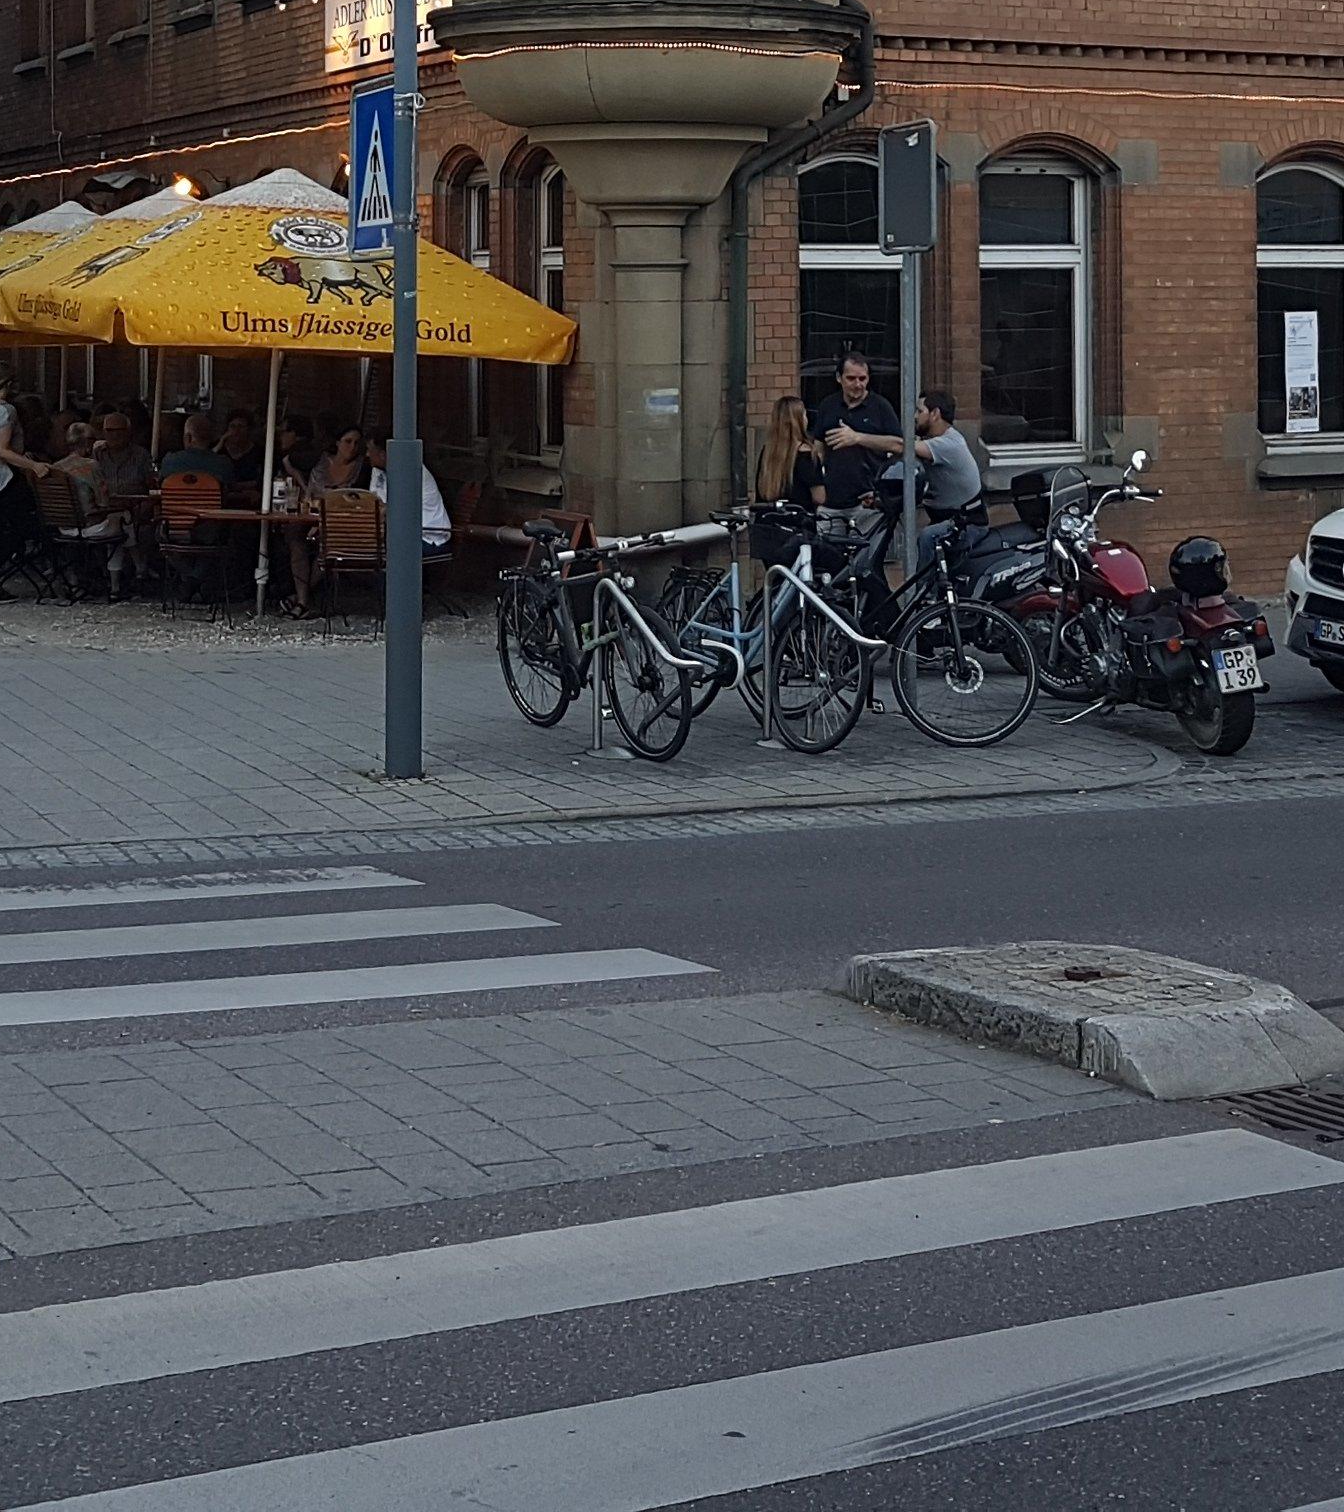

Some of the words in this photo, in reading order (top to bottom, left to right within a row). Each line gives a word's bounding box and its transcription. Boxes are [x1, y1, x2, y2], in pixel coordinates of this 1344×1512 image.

[333, 0, 367, 29] ADLER
[220, 310, 289, 334] Ulms
[293, 311, 393, 340] flüssige
[415, 318, 473, 344] Gold
[1320, 622, 1332, 638] GP
[1222, 650, 1244, 670] GP
[1236, 668, 1257, 687] 39
